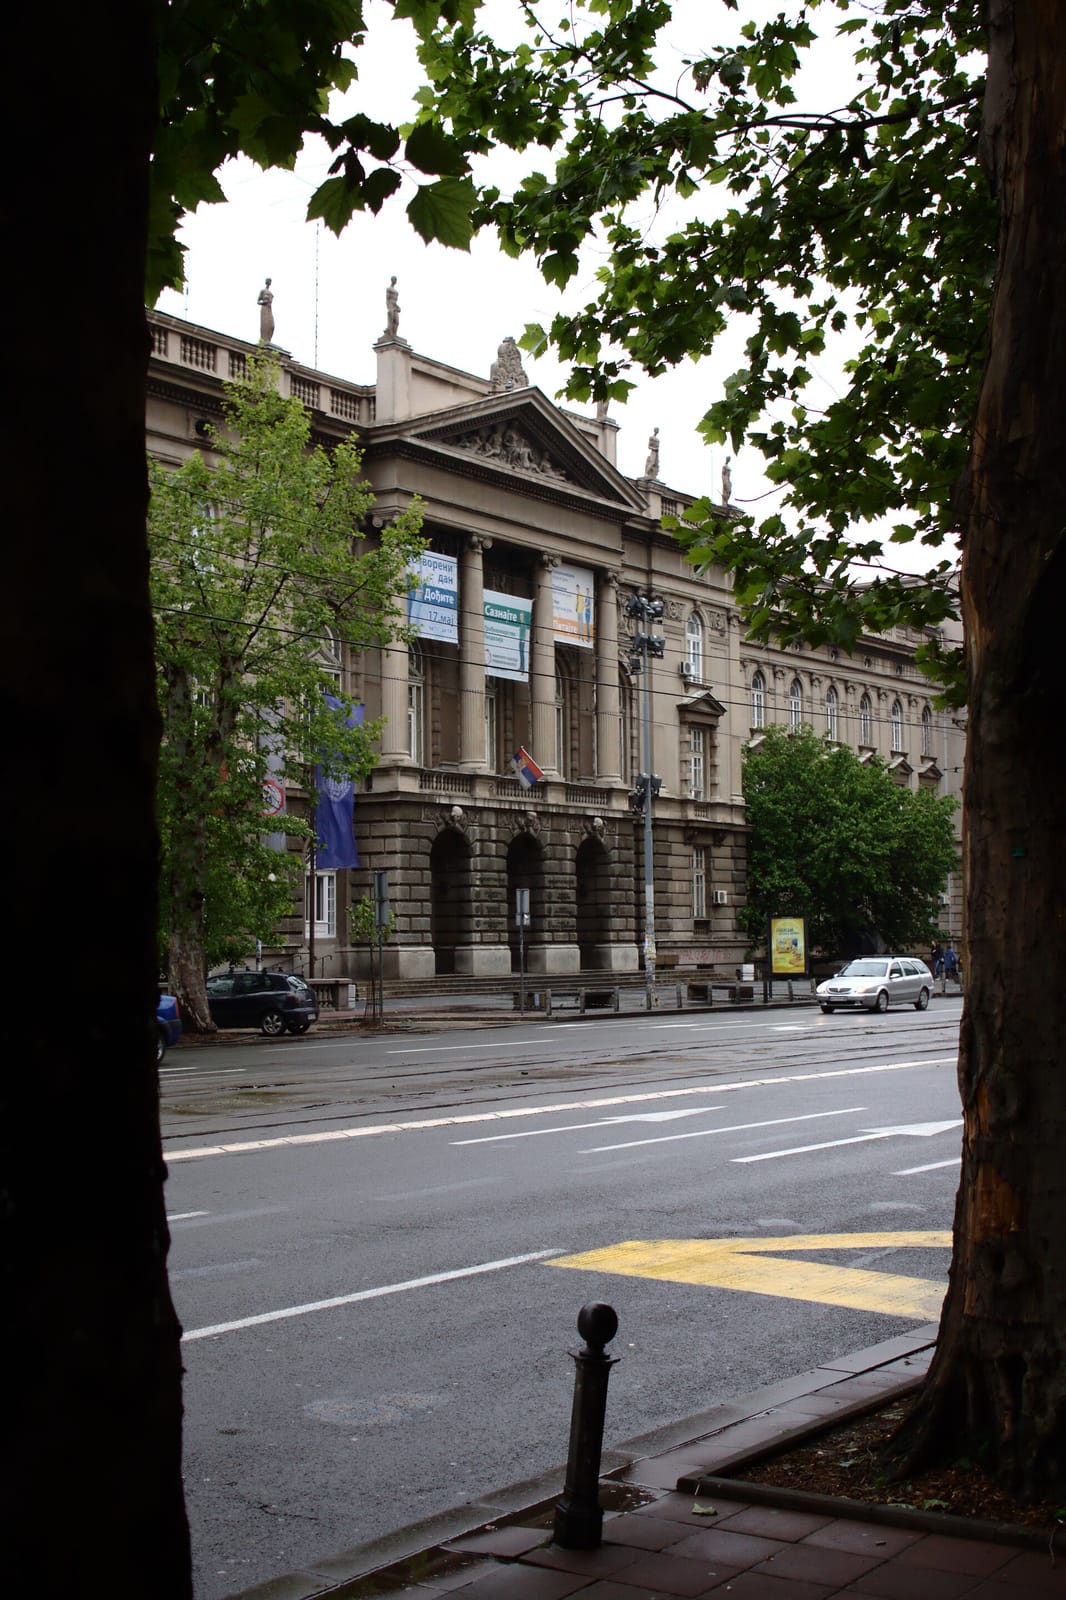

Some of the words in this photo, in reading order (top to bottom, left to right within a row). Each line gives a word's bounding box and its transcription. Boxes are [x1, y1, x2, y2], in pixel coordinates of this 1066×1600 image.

[438, 573, 453, 585] дан
[424, 588, 455, 605] Дођите
[484, 605, 518, 623] Сазнајте
